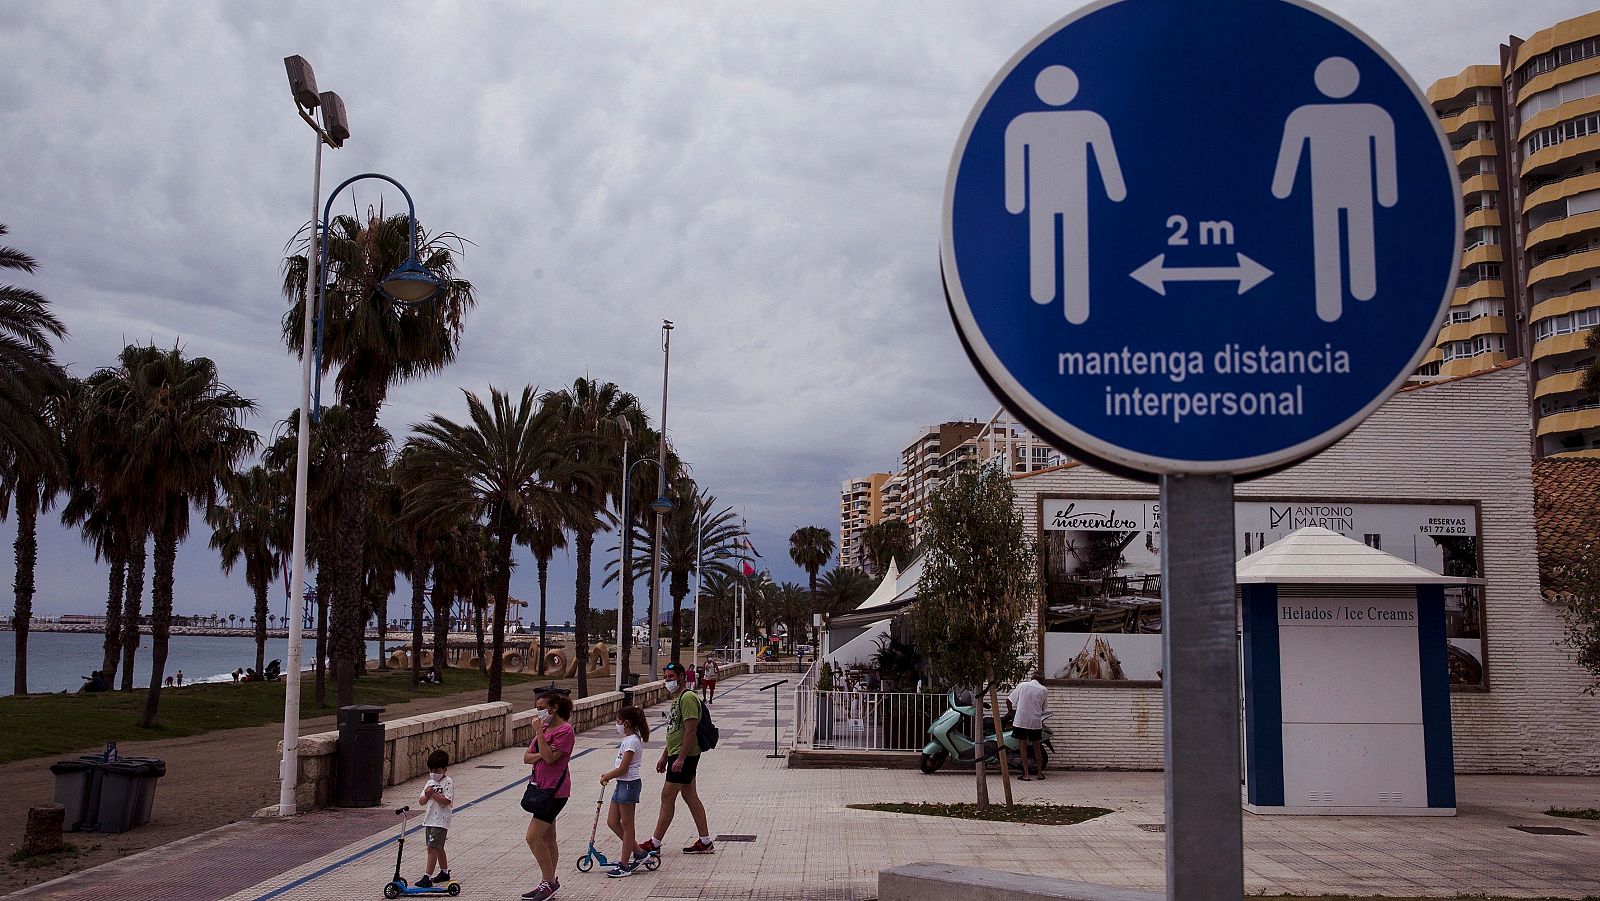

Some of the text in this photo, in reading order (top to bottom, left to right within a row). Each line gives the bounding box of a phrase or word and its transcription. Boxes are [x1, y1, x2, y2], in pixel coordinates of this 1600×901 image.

[1166, 214, 1235, 246] 2 m
[1058, 343, 1350, 382] mantenga distancia
[1105, 385, 1303, 423] interpersonal
[1055, 502, 1086, 519] el
[1294, 506, 1353, 517] ANTONIO
[1052, 510, 1137, 529] merendero
[1428, 517, 1466, 526] RESERVAS
[1419, 525, 1432, 533] 951
[1456, 526, 1467, 534] 02
[1281, 606, 1333, 620] Helados
[1345, 607, 1364, 620] Ice
[1367, 607, 1414, 620] Creams
